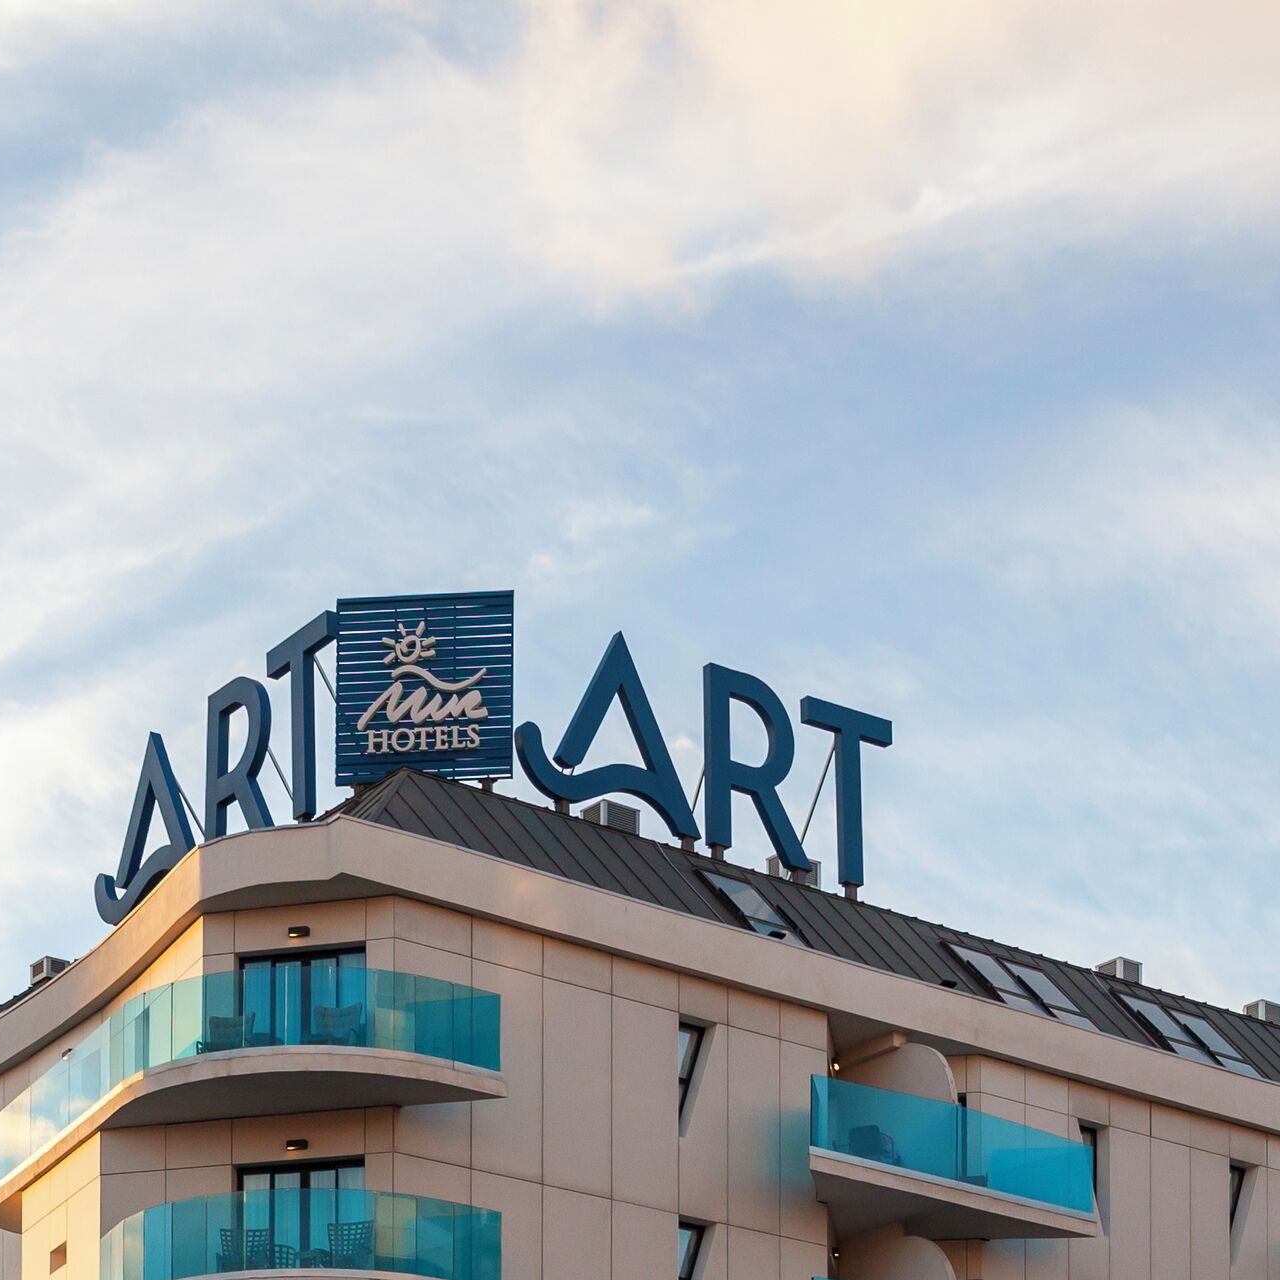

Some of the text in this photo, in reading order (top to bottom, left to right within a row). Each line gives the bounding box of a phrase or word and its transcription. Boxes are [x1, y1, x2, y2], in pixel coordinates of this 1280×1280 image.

[94, 610, 337, 926] ART
[367, 724, 481, 754] HOTELS
[515, 630, 893, 886] ART
